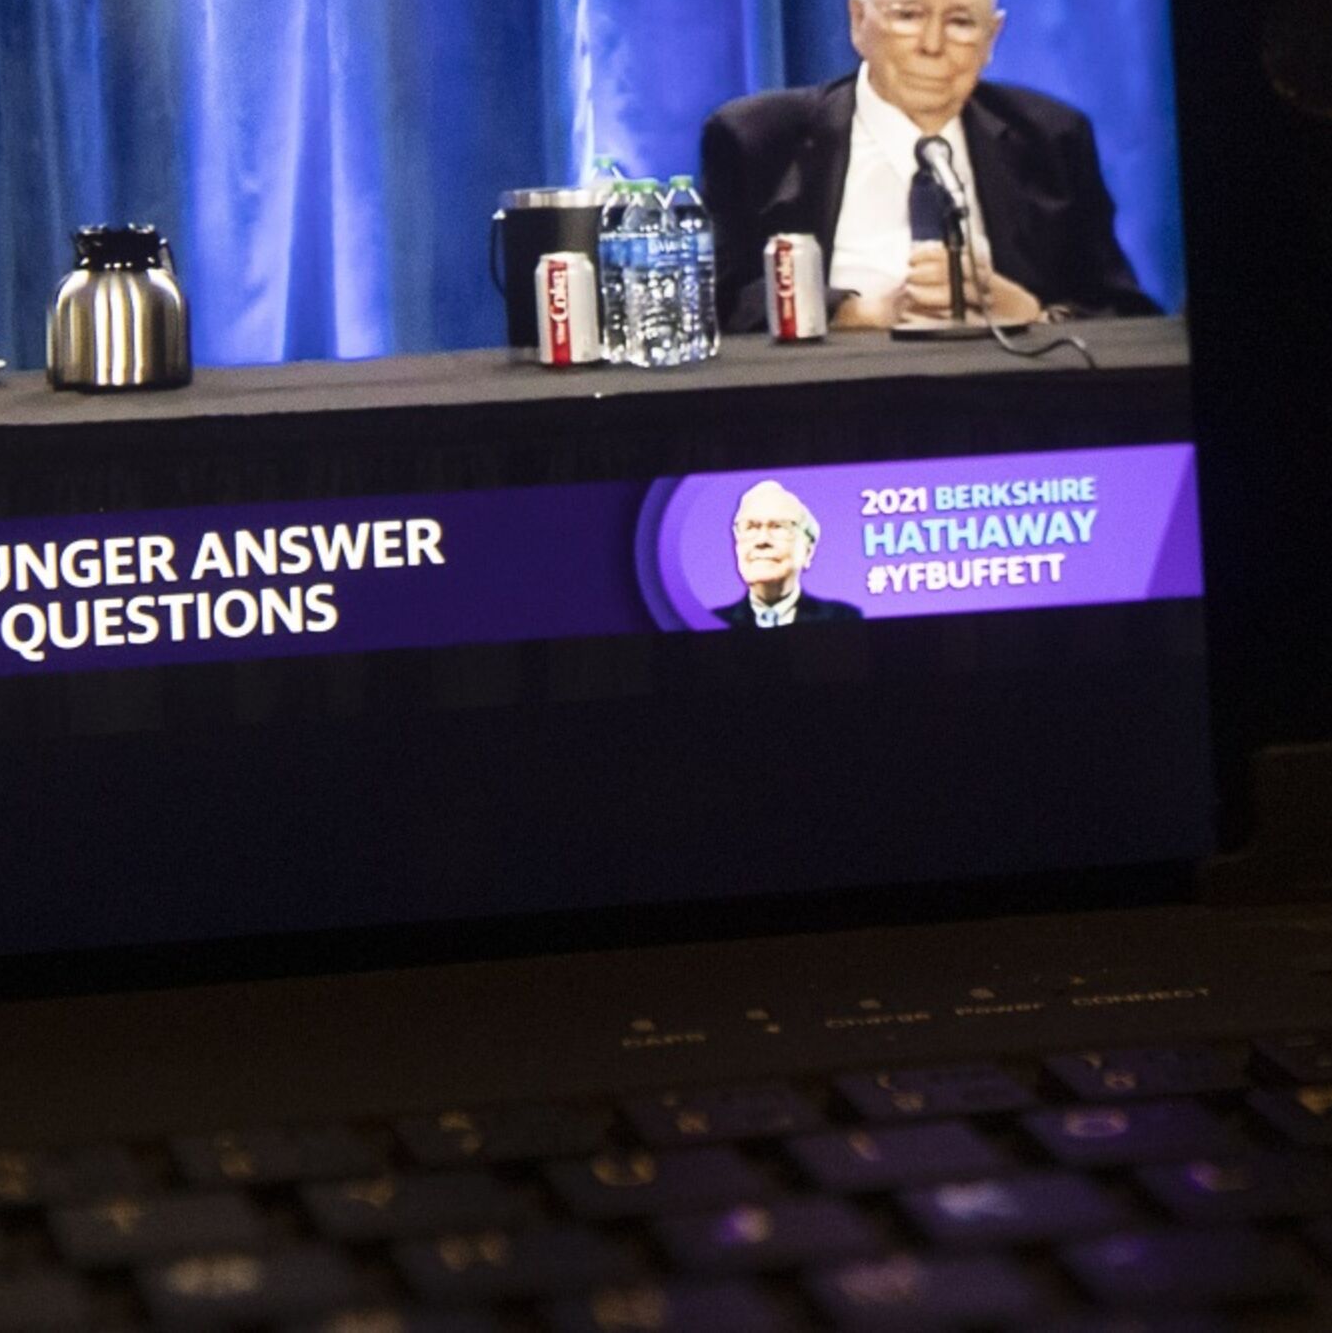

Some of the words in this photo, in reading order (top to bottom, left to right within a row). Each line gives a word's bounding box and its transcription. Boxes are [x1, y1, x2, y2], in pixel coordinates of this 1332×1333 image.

[861, 487, 928, 516] 2021
[934, 477, 1097, 512] BERKSHIRE
[190, 518, 446, 580] ANSWER
[863, 509, 1097, 556] HATHAWAY
[867, 553, 1065, 594] #YFBUFFETT
[0, 584, 338, 662] QUESTIONS
